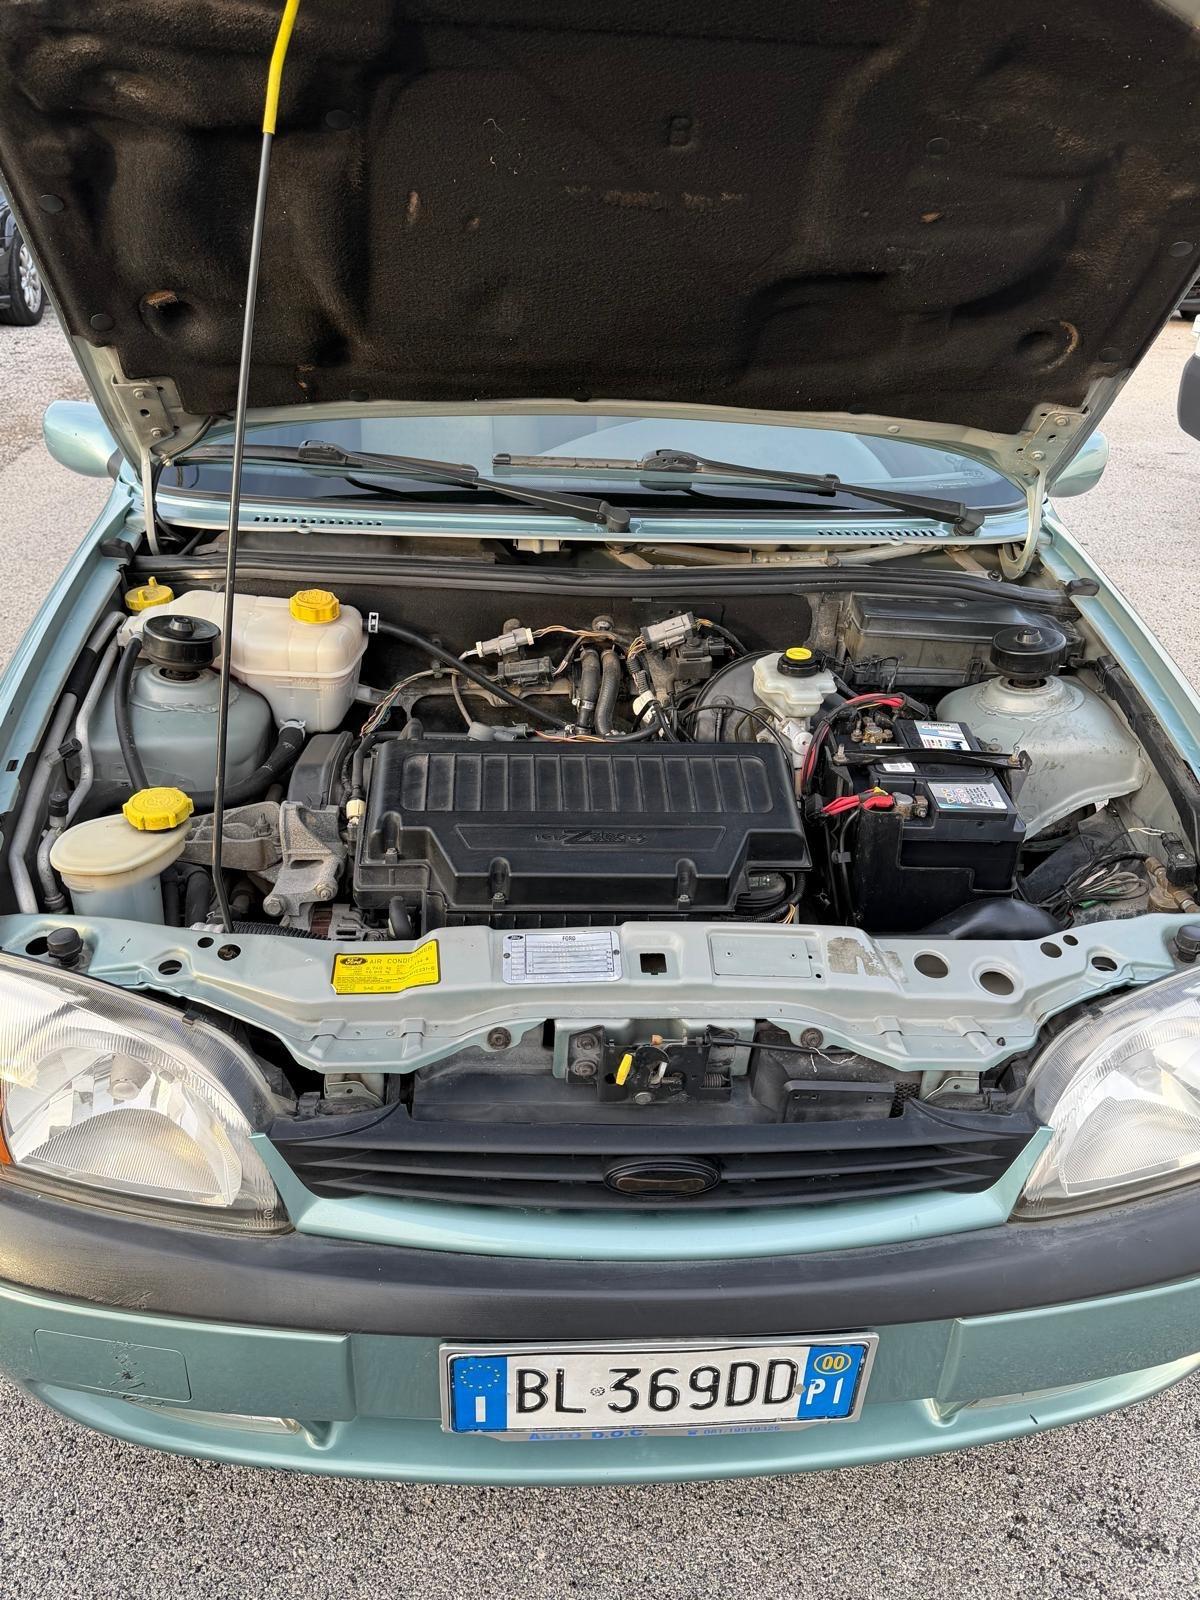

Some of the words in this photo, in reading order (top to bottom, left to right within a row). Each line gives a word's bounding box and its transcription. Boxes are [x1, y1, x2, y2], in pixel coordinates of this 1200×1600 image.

[343, 957, 364, 965] Ford
[822, 1355, 844, 1370] 00
[516, 1368, 587, 1414] BL
[608, 1358, 799, 1413] 369DD
[805, 1377, 844, 1405] PI
[475, 1396, 486, 1423] I
[529, 1431, 581, 1441] AUTO
[591, 1428, 648, 1439] D.O.C.
